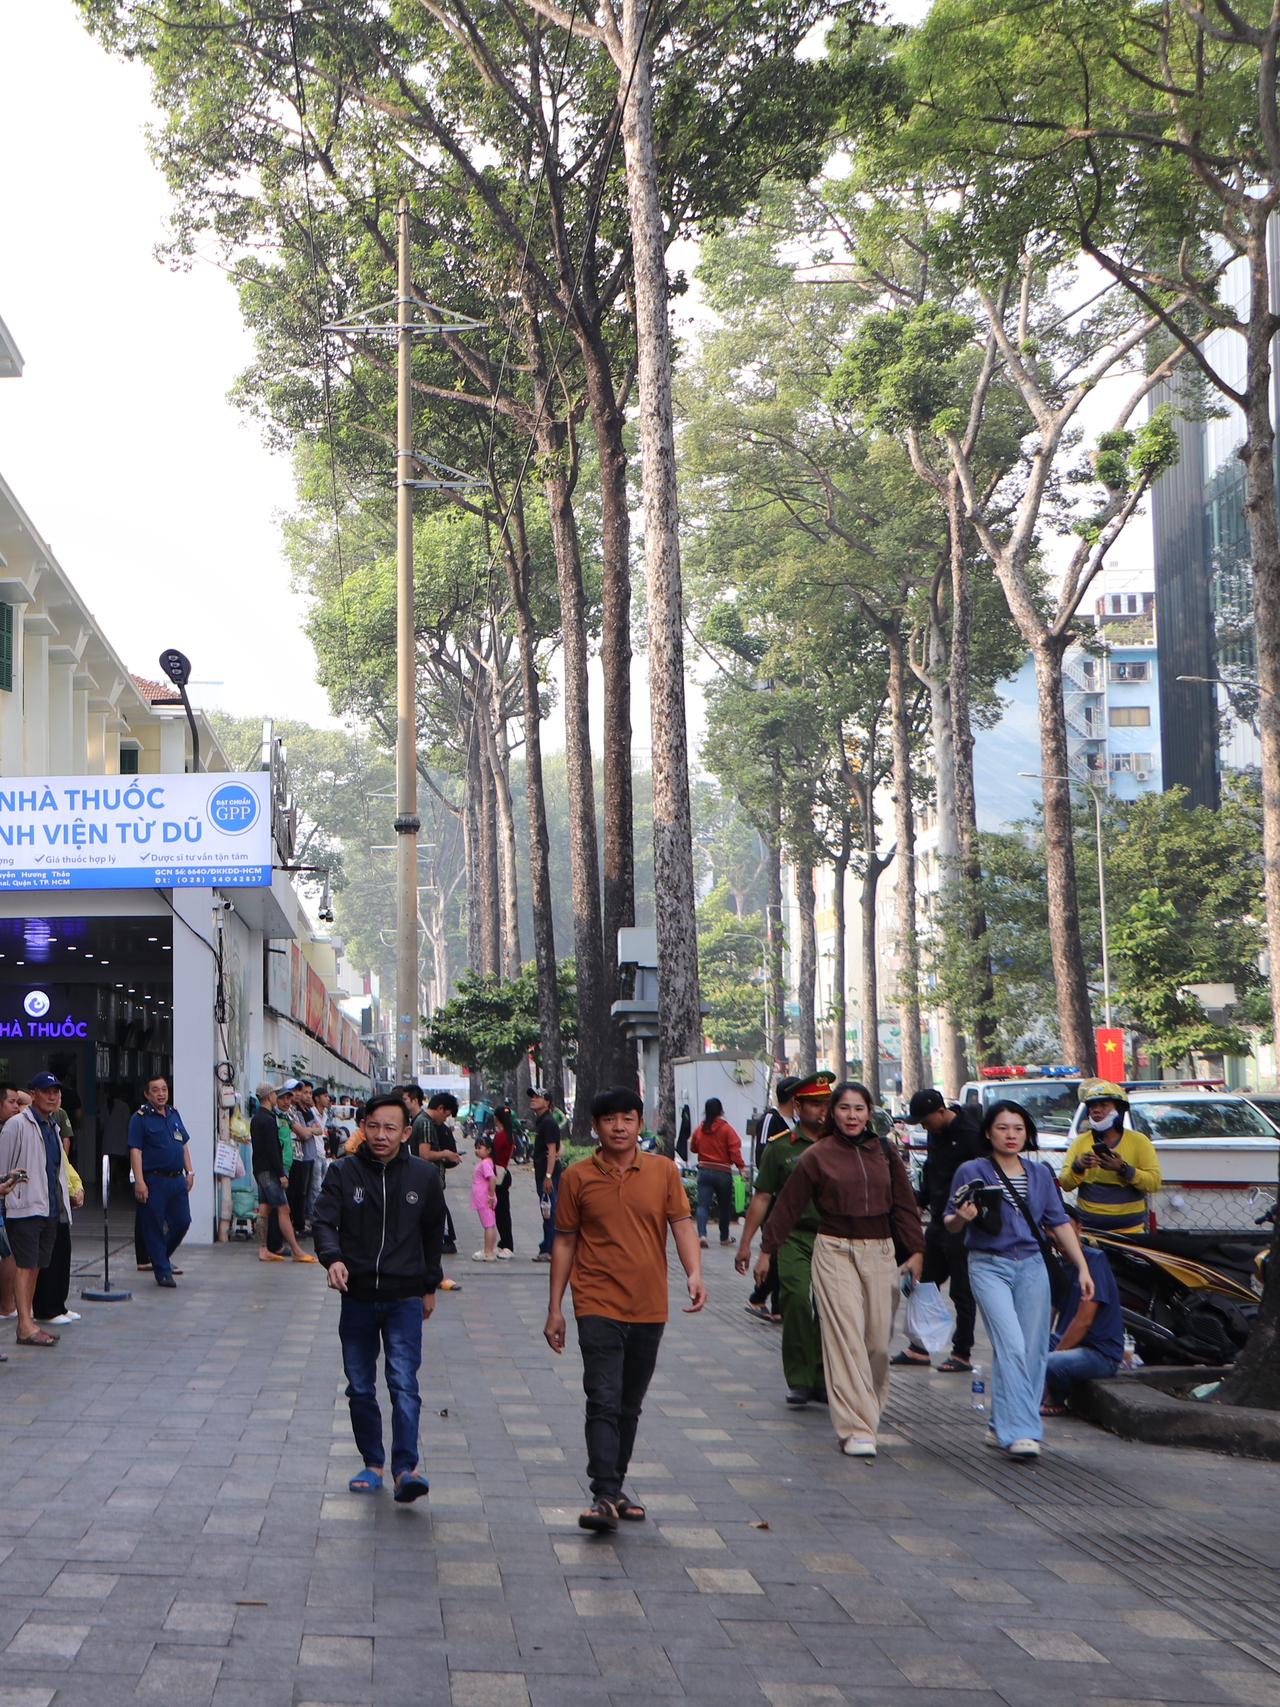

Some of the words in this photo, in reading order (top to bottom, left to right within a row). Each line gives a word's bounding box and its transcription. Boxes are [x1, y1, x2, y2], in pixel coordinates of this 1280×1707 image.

[64, 778, 166, 811] THUỐC
[229, 796, 251, 806] CHUẨN
[216, 807, 251, 820] GPP
[42, 818, 108, 850] VIỆN
[116, 816, 156, 844] TỪ
[162, 816, 202, 843] DŨ
[45, 856, 60, 864] Giá
[62, 854, 87, 863] thuốc
[89, 855, 106, 864] hợp
[108, 854, 116, 864] lý
[151, 854, 174, 863] Dược
[176, 853, 184, 861] sĩ
[197, 852, 213, 861] vấn
[215, 853, 229, 862] tận
[231, 852, 248, 860] tâm
[21, 871, 47, 879] Hương
[212, 875, 262, 883] 54042837
[12, 879, 32, 887] Quận
[27, 1014, 88, 1037] THUỐC
